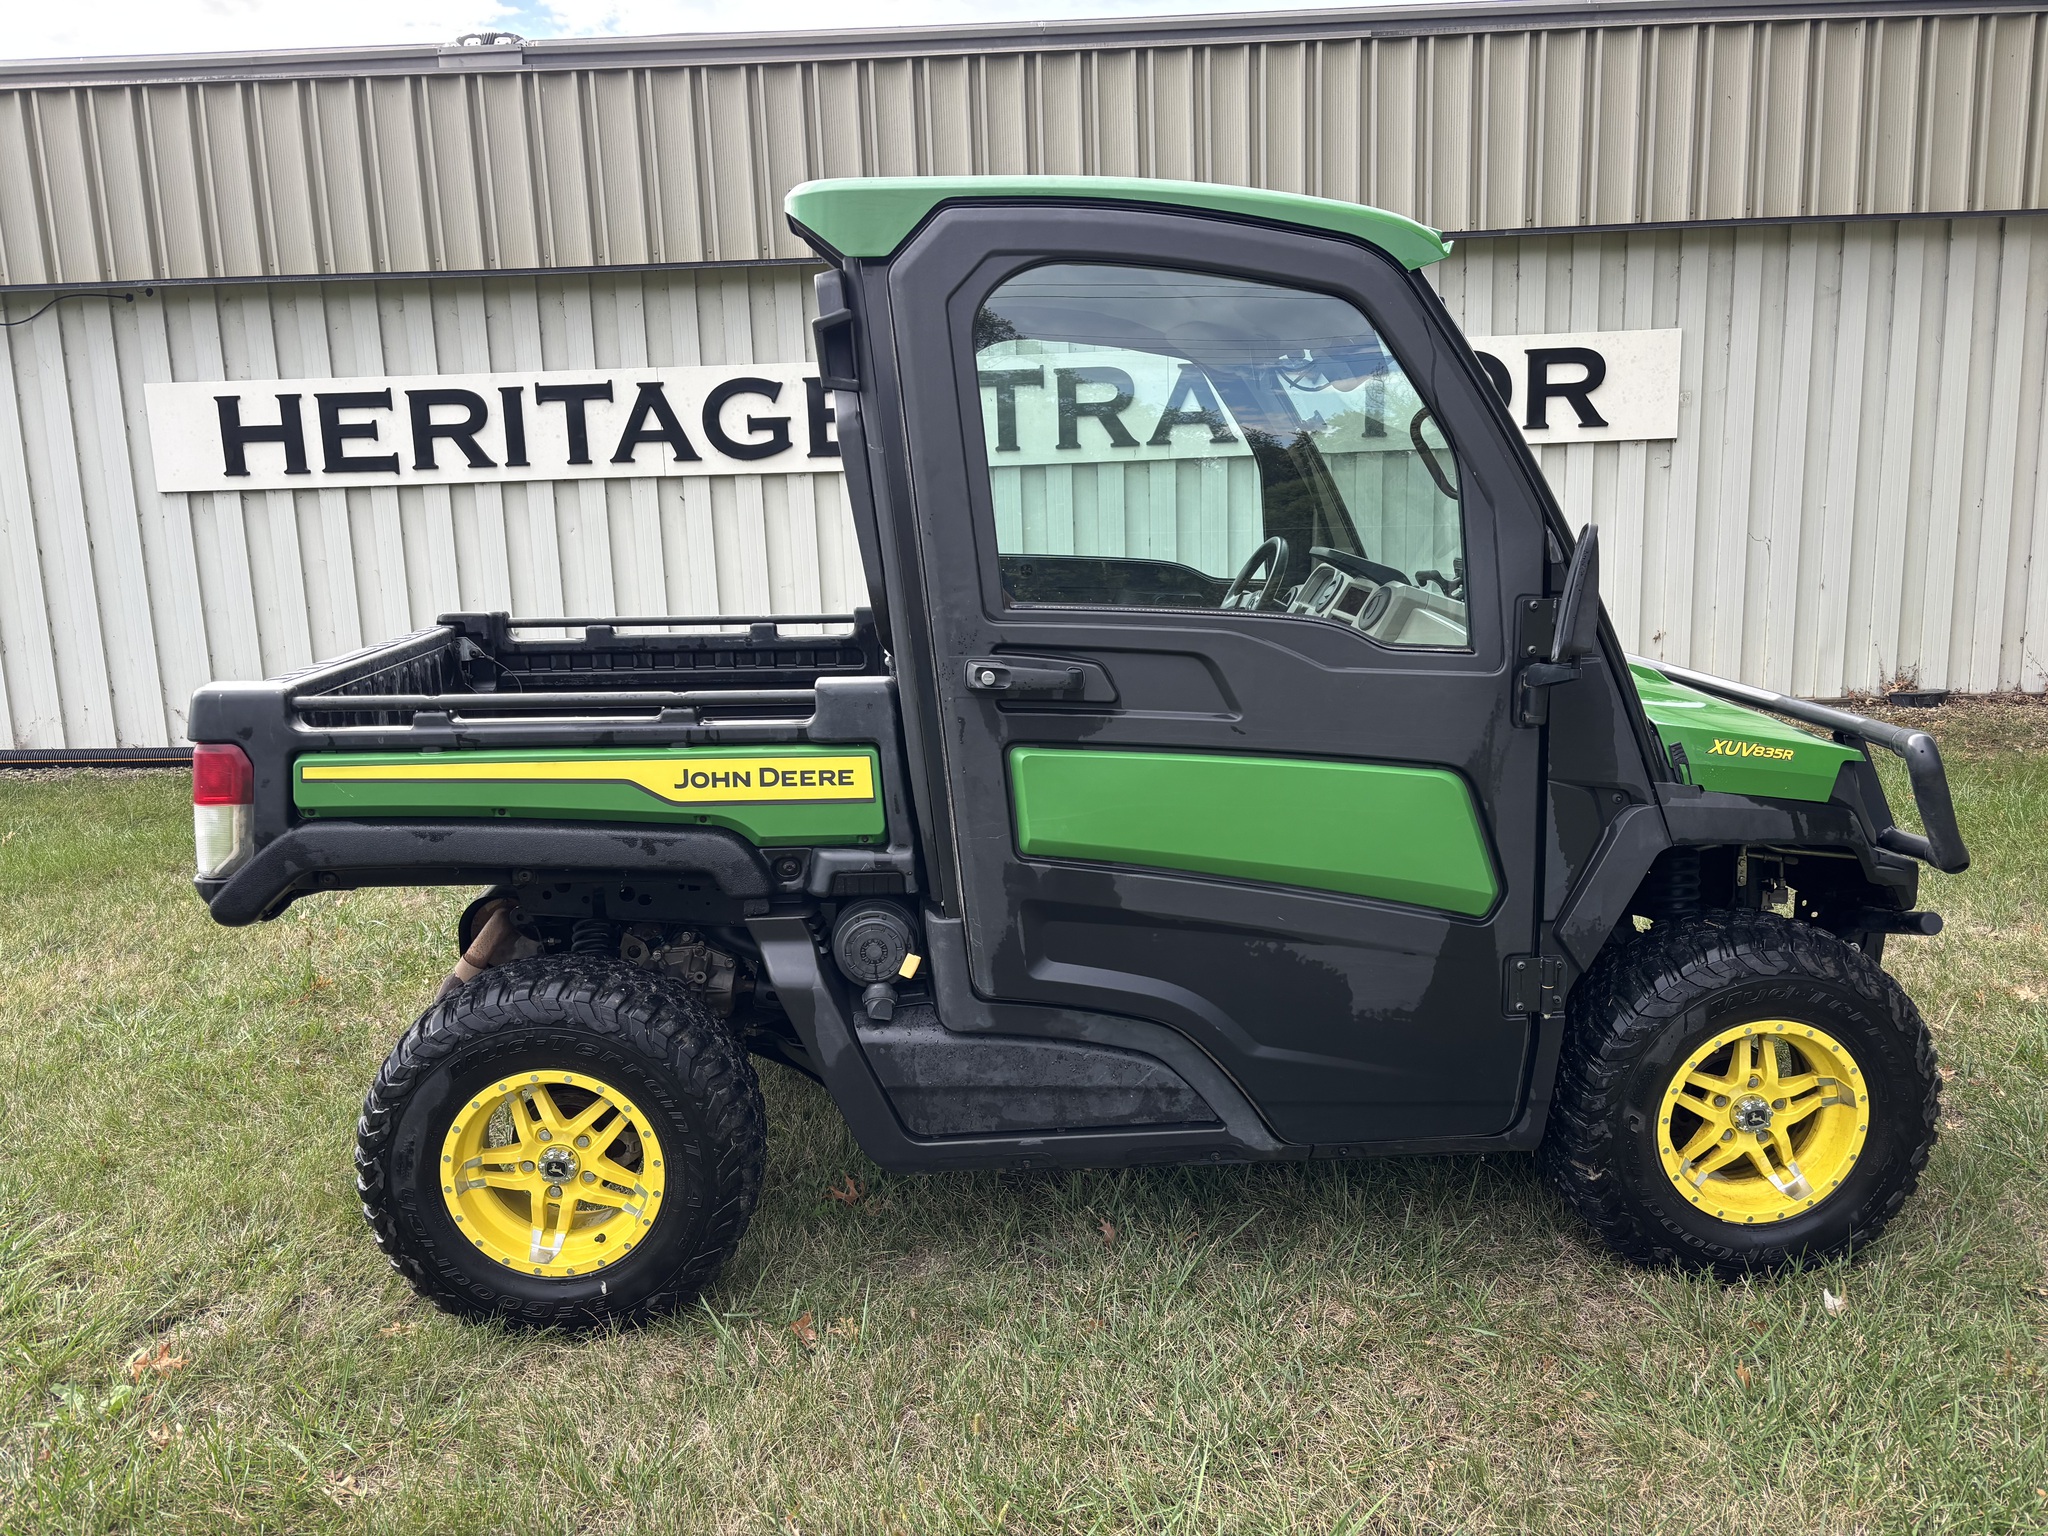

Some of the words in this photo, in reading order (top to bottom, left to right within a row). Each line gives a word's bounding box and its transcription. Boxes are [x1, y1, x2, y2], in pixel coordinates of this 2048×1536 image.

[213, 377, 841, 477] HERITAGE
[978, 347, 1609, 451] TRAR
[674, 768, 751, 789] JOHN
[759, 767, 854, 787] DEERE
[1705, 737, 1795, 761] XUV835R
[1710, 984, 1905, 1081] Mud-Terra
